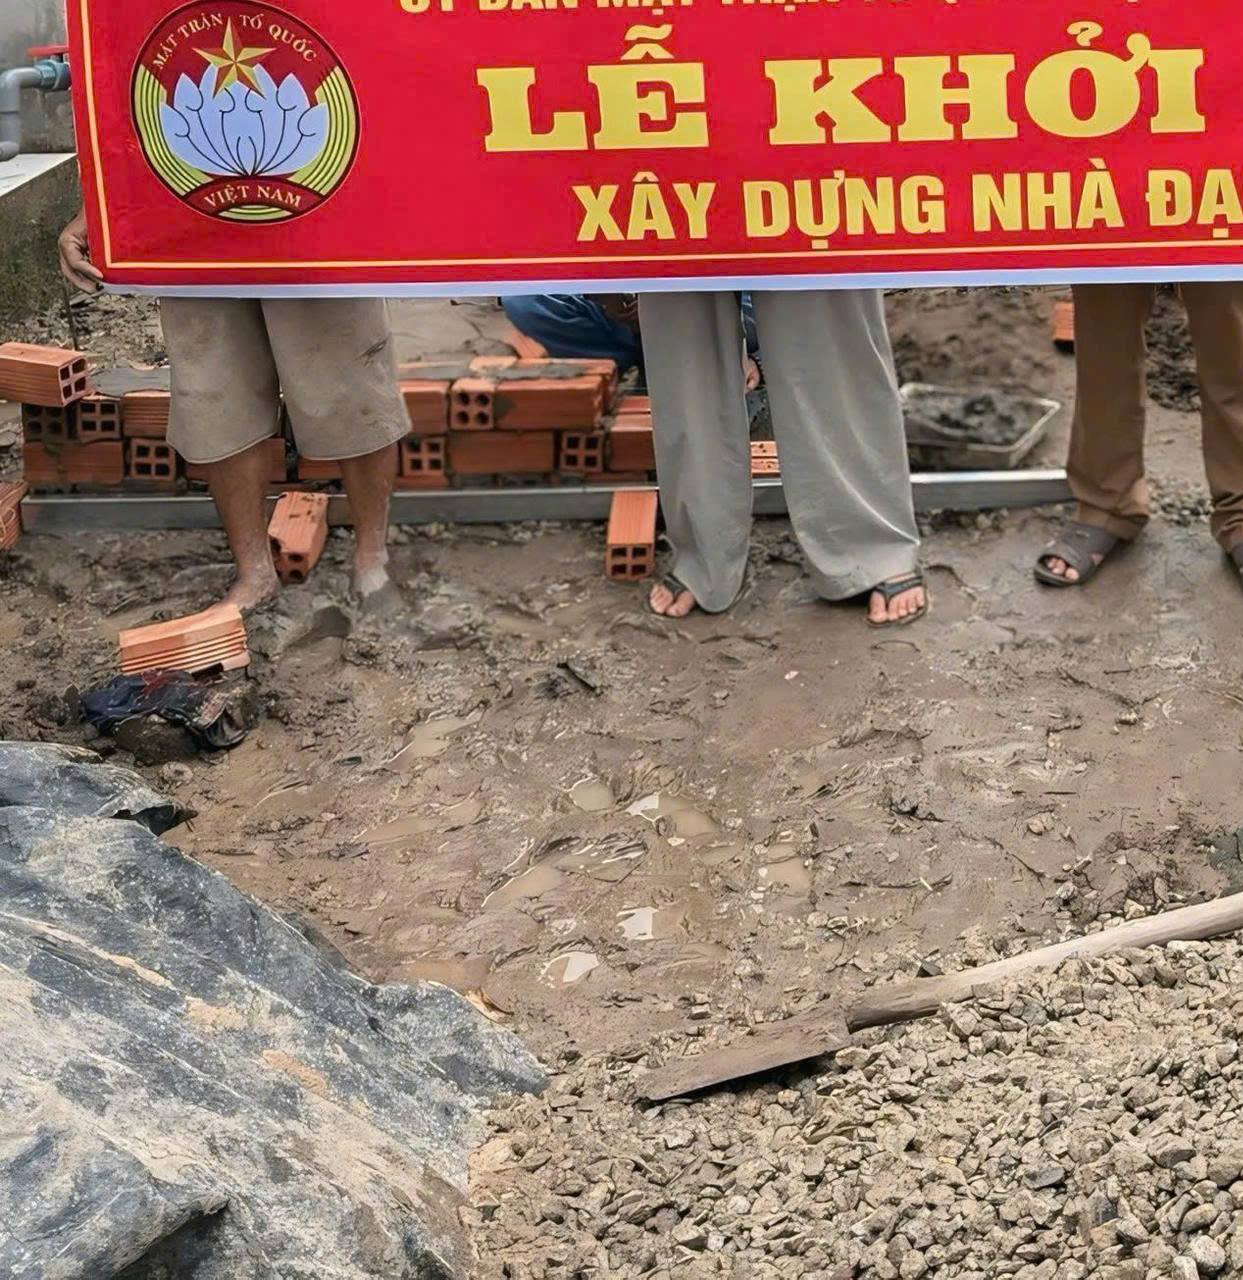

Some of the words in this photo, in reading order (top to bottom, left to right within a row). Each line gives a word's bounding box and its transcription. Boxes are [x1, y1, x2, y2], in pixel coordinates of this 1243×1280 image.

[476, 23, 711, 153] LỄ
[764, 21, 1207, 147] KHỞI
[257, 184, 302, 208] NAM
[573, 171, 718, 243] XÂY
[743, 170, 948, 251] DỰNG
[972, 158, 1125, 234] NHÀ
